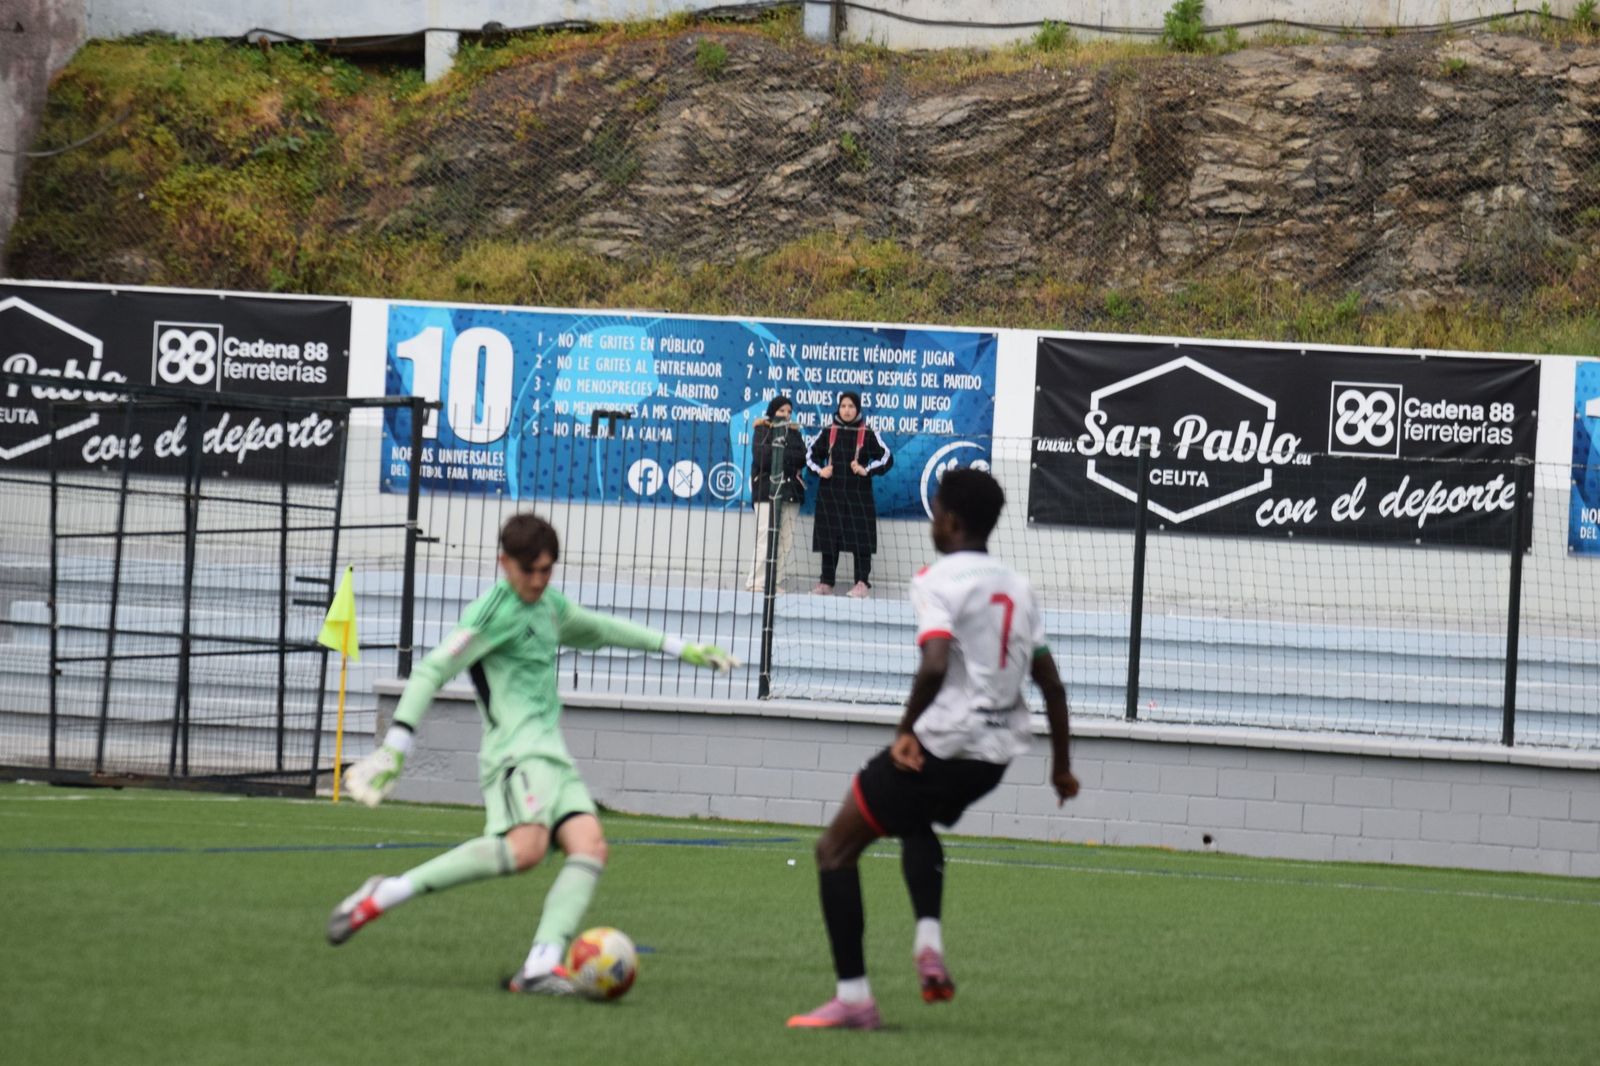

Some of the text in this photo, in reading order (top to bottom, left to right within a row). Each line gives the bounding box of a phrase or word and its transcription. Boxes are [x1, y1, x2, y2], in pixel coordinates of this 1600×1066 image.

[224, 337, 329, 362] Cadena 88
[537, 332, 705, 354] 1 NO ME GRITES EN PÚBLICO
[747, 340, 955, 368] 6 RÍE Y DIVIÉRTETE VIÉNDOME JUGAR
[224, 358, 327, 383] ferreterías
[535, 354, 722, 378] 2 NO LE GRITES AL ENTRENADOR
[746, 364, 982, 390] 7 NO ME DES LECCIONES DESPUÉS DEL PARTIDO
[396, 326, 514, 443] 10
[534, 377, 719, 400] 3 NO MENOSPRECIES AL ÁRBITRO
[744, 386, 751, 402] 8
[762, 387, 777, 402] NO
[796, 389, 833, 406] OLVIDES
[533, 399, 540, 413] 4
[555, 400, 569, 415] NO
[641, 405, 649, 419] A
[671, 403, 731, 424] COMPAÑEROS
[860, 392, 872, 408] ES
[875, 393, 899, 409] SOLO
[903, 394, 917, 410] UN
[920, 395, 951, 413] JUEGO
[1404, 397, 1515, 423] Cadena 88
[743, 410, 750, 424] 9
[796, 412, 816, 427] QUE
[865, 415, 895, 432] MEJOR
[898, 417, 919, 432] QUE
[922, 418, 954, 434] PUEDA
[82, 411, 334, 464] con el deporte
[532, 421, 539, 435] 5
[553, 422, 568, 437] NO
[1404, 418, 1513, 445] ferreterías
[438, 448, 504, 465] UNIVERSALES
[391, 464, 407, 477] DEL
[1149, 468, 1209, 488] CEUTA
[1255, 474, 1516, 529] con el deporte
[1580, 508, 1600, 524] NO
[1580, 527, 1597, 539] DEL
[990, 592, 1014, 670] 7
